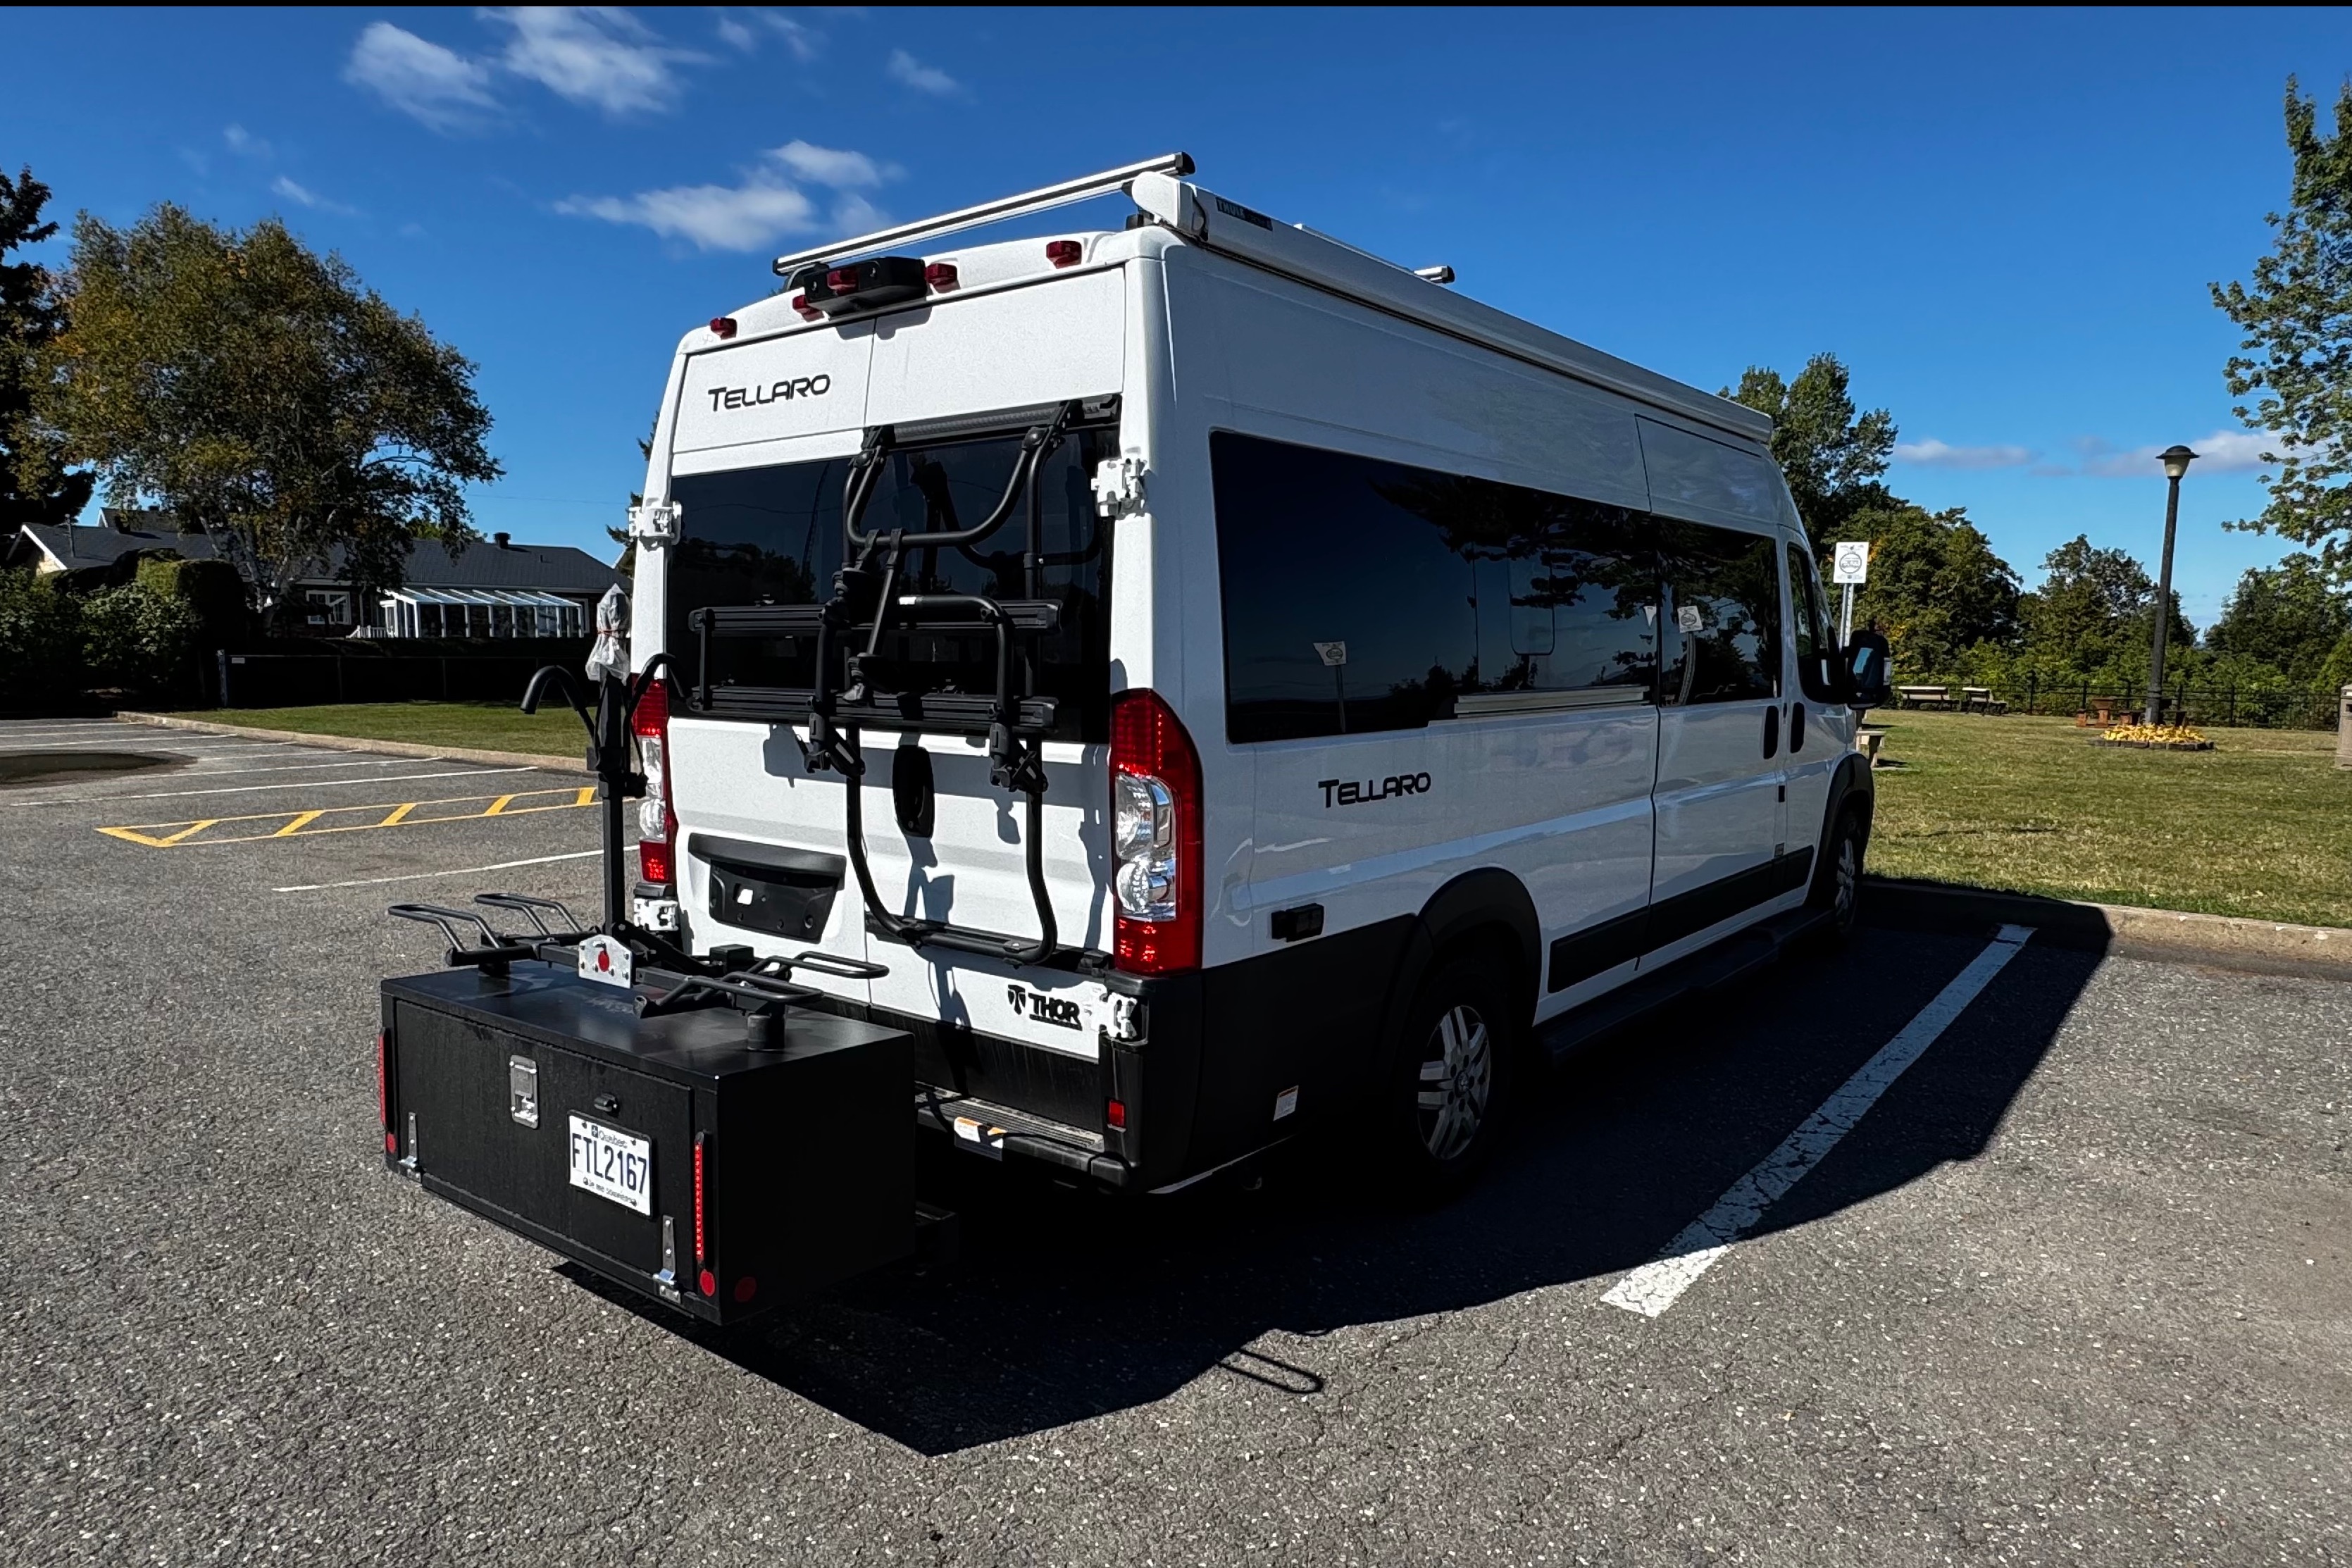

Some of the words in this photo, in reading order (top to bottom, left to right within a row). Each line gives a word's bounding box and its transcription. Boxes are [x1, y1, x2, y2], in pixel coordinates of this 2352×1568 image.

[1217, 199, 1245, 219] THULE
[708, 374, 830, 411] TELLARO
[1318, 772, 1431, 808] TELLARO
[1028, 993, 1082, 1026] THOR
[572, 1133, 647, 1195] FTL2167
